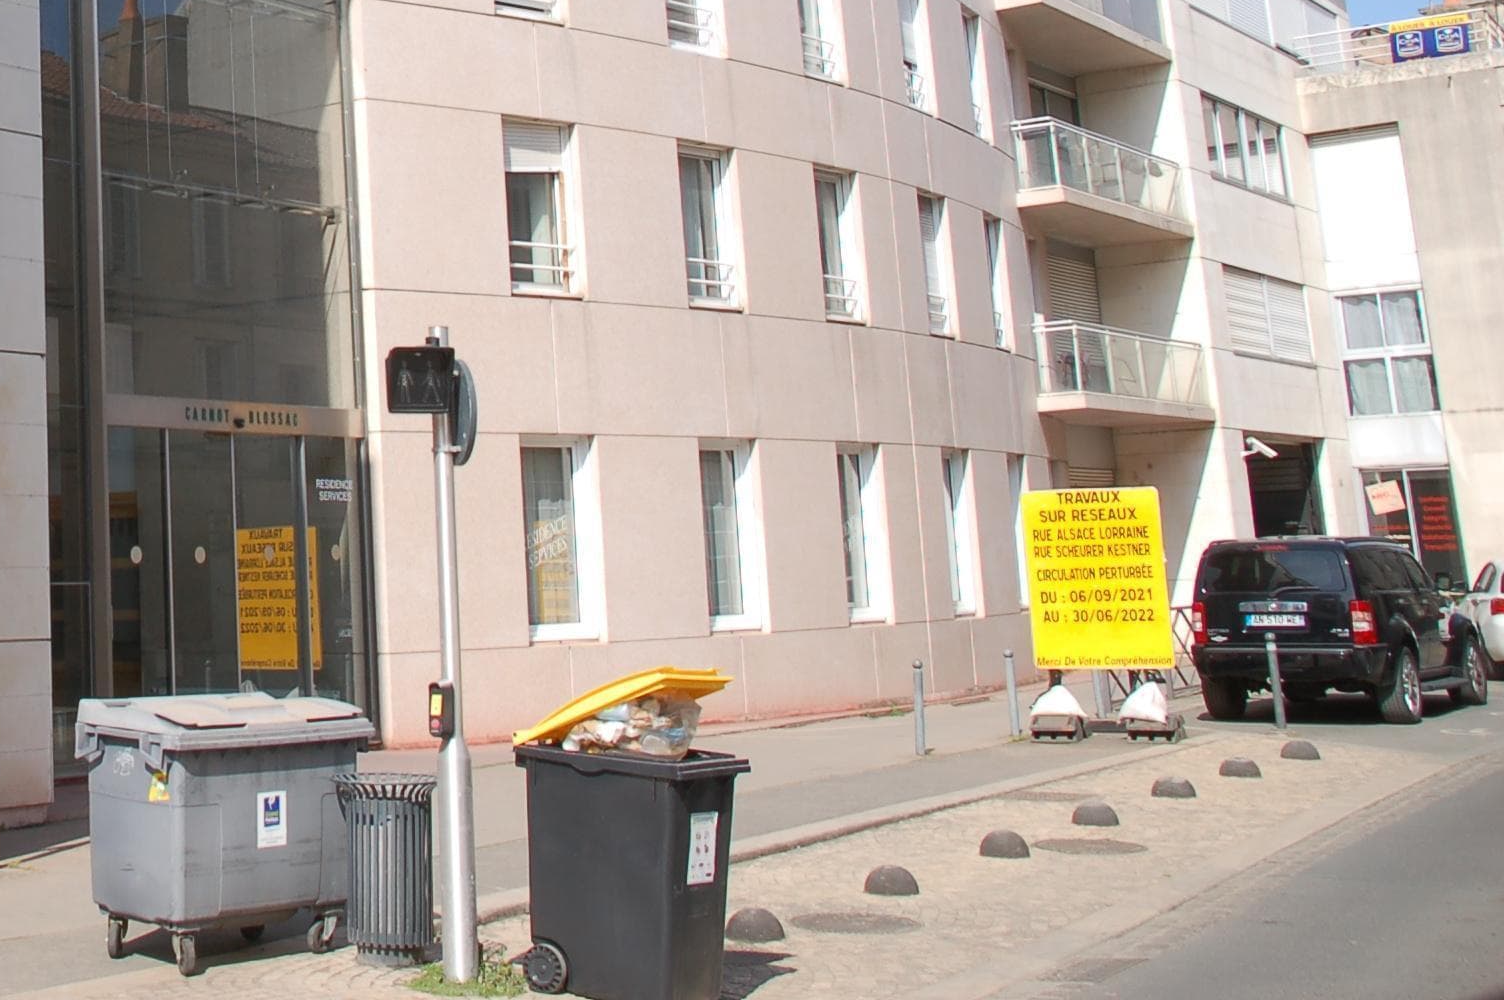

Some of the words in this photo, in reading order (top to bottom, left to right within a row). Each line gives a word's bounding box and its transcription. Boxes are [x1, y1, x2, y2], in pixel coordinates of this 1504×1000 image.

[185, 406, 230, 423] CARNOT
[248, 410, 299, 427] BLOSSAC
[319, 489, 353, 502] SERVICES
[1056, 490, 1120, 504] TRAVAUX
[1039, 509, 1066, 523] SUR
[1072, 507, 1138, 521] RESEAUX
[1032, 529, 1053, 541] RUE
[1057, 527, 1096, 540] ALSACE
[1099, 525, 1150, 540] LORRAINE
[1034, 545, 1053, 558] RUE
[1056, 544, 1104, 558] SCHEURER
[1107, 543, 1151, 557] KESTNER
[1036, 567, 1095, 582] CIRCULATION
[1099, 564, 1154, 580] PERTURBÉE
[1040, 590, 1057, 604] DU
[1069, 588, 1153, 604] 06/09/2021
[1043, 609, 1060, 623] AU
[1073, 608, 1156, 623] 30/06/2022
[1037, 656, 1062, 667] Merci
[1065, 656, 1076, 666] De
[1079, 656, 1102, 666] Votre
